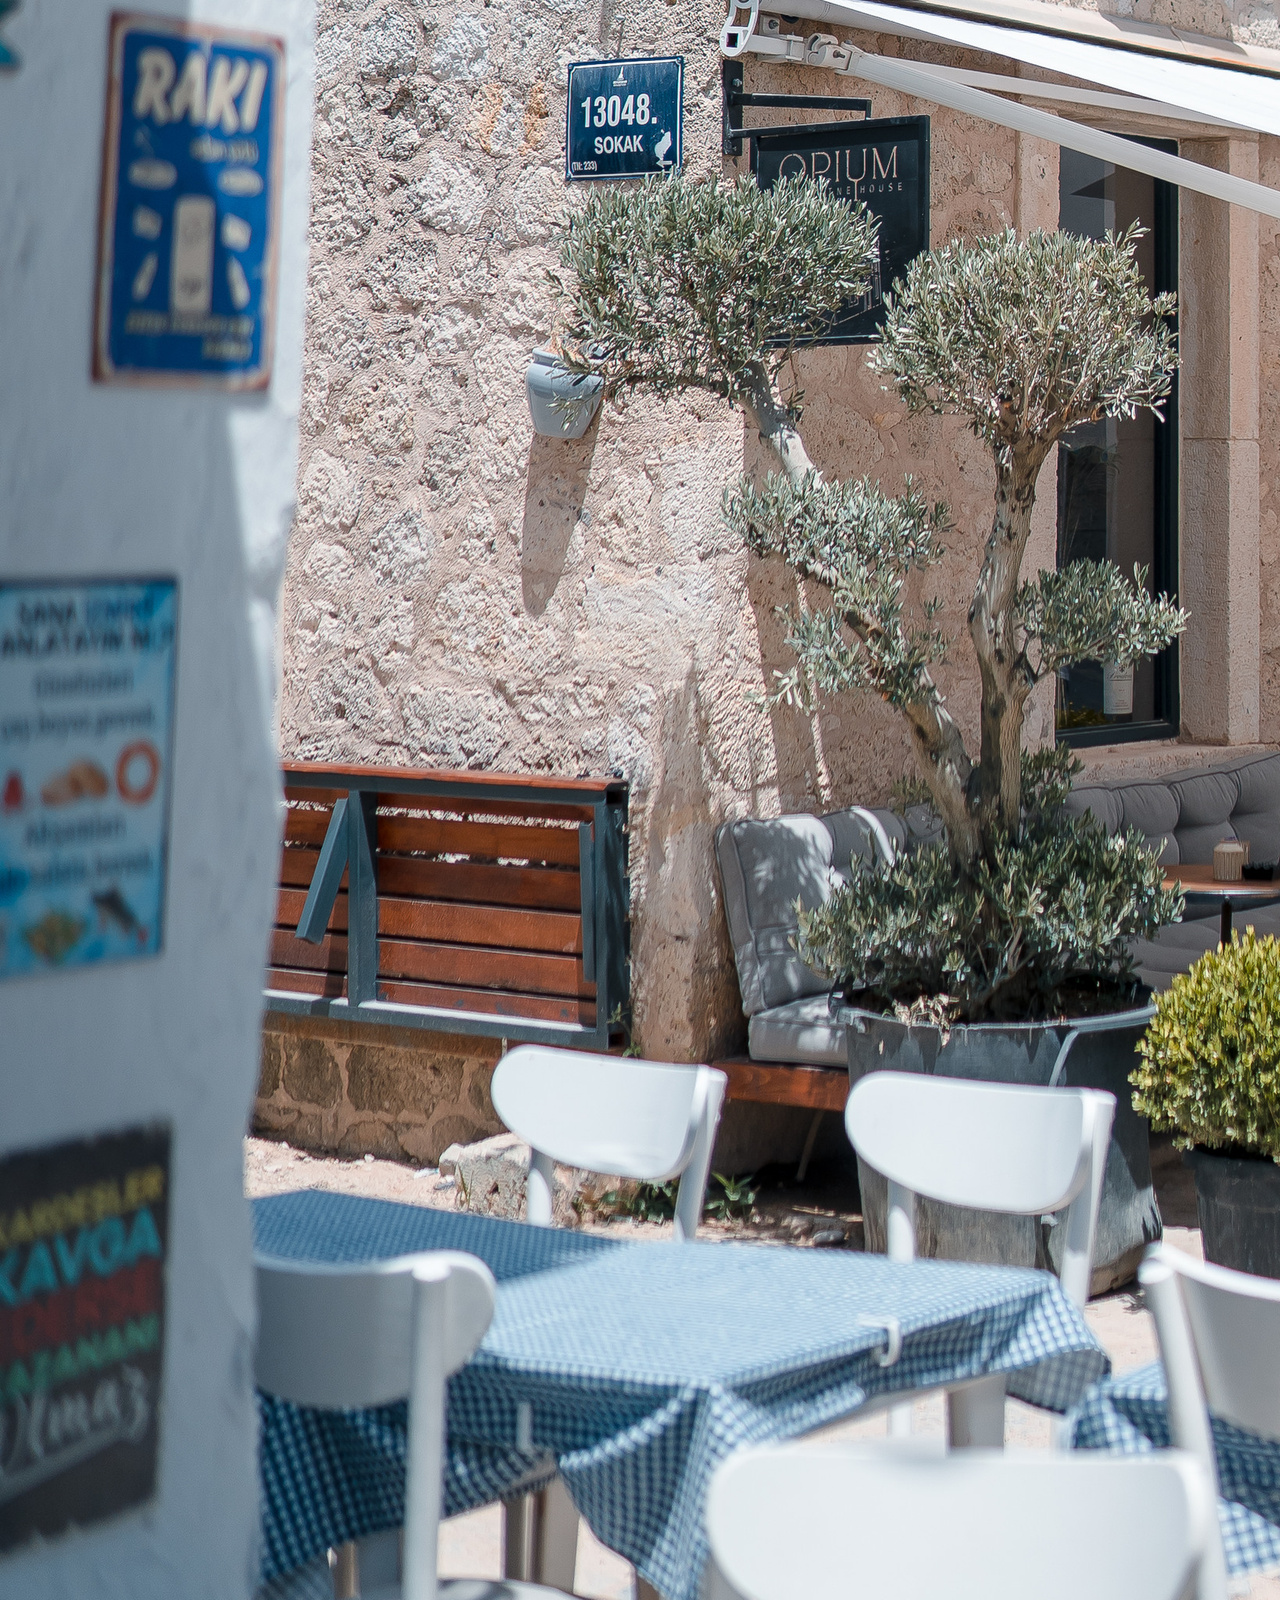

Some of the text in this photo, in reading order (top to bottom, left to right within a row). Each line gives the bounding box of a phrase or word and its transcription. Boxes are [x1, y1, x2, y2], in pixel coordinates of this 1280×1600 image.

[133, 46, 268, 136] RAKI
[581, 93, 657, 128] 13048.
[594, 135, 643, 154] SOKAK
[779, 145, 898, 201] OPIUM
[859, 181, 903, 195] HOUSE
